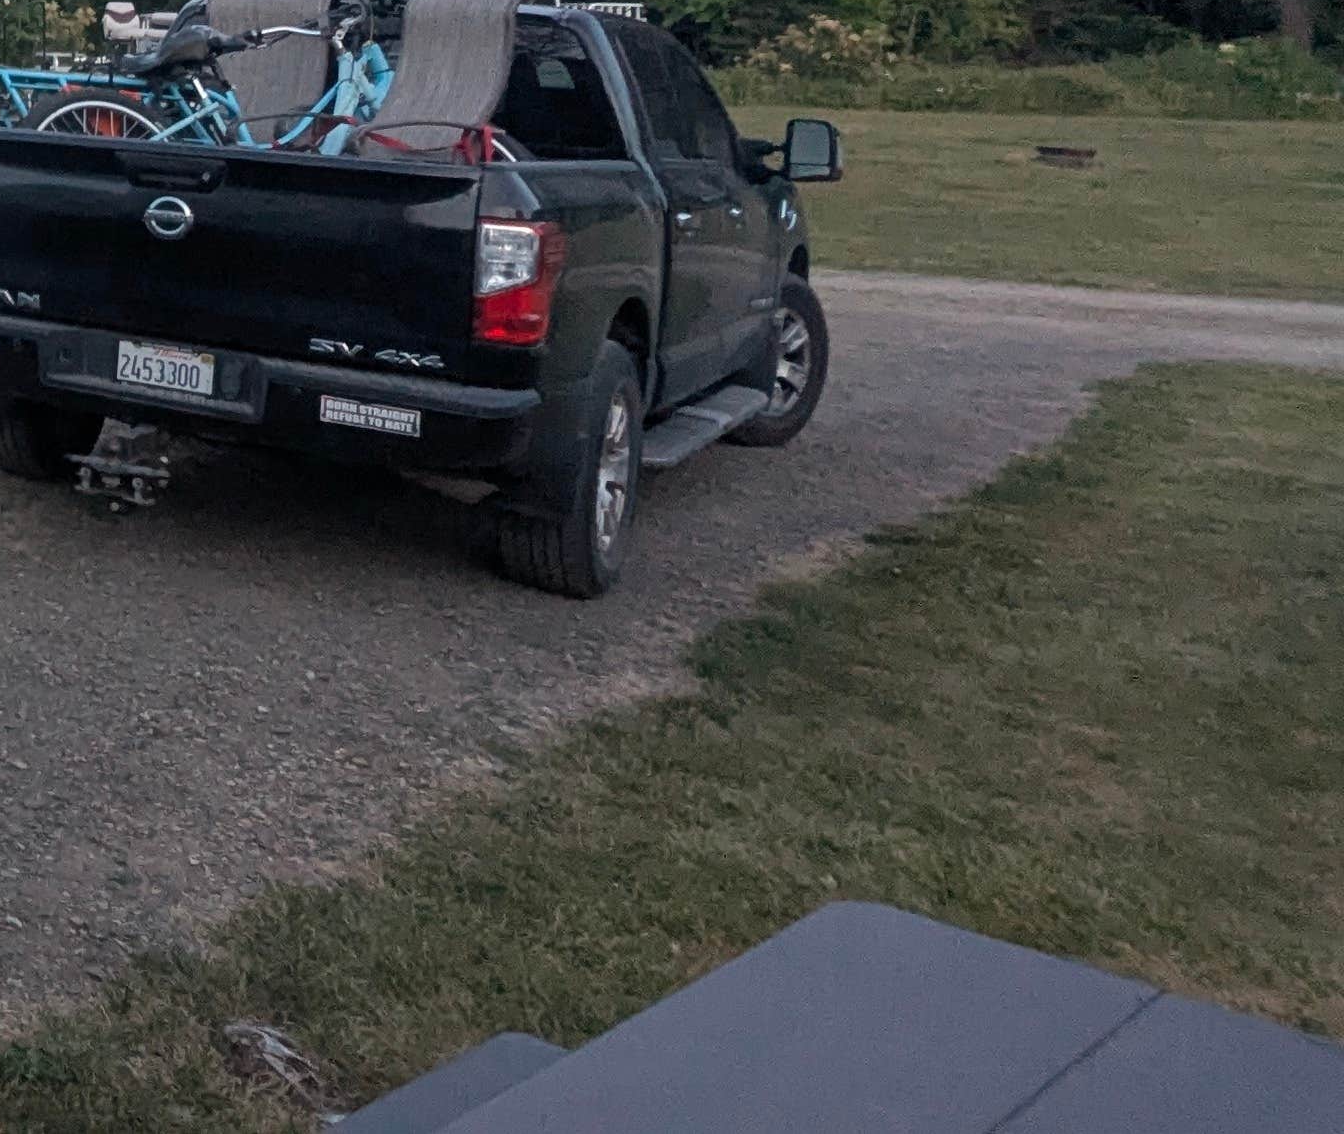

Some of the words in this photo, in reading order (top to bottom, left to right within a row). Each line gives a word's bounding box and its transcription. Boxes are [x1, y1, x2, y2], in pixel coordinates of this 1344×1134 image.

[309, 337, 364, 357] SV
[119, 353, 201, 389] 2453300
[325, 409, 367, 425] REFUSE
[368, 416, 383, 428] TO
[384, 419, 413, 433] HATE
[326, 399, 358, 416] BORN
[359, 405, 416, 423] STRAIGHT
